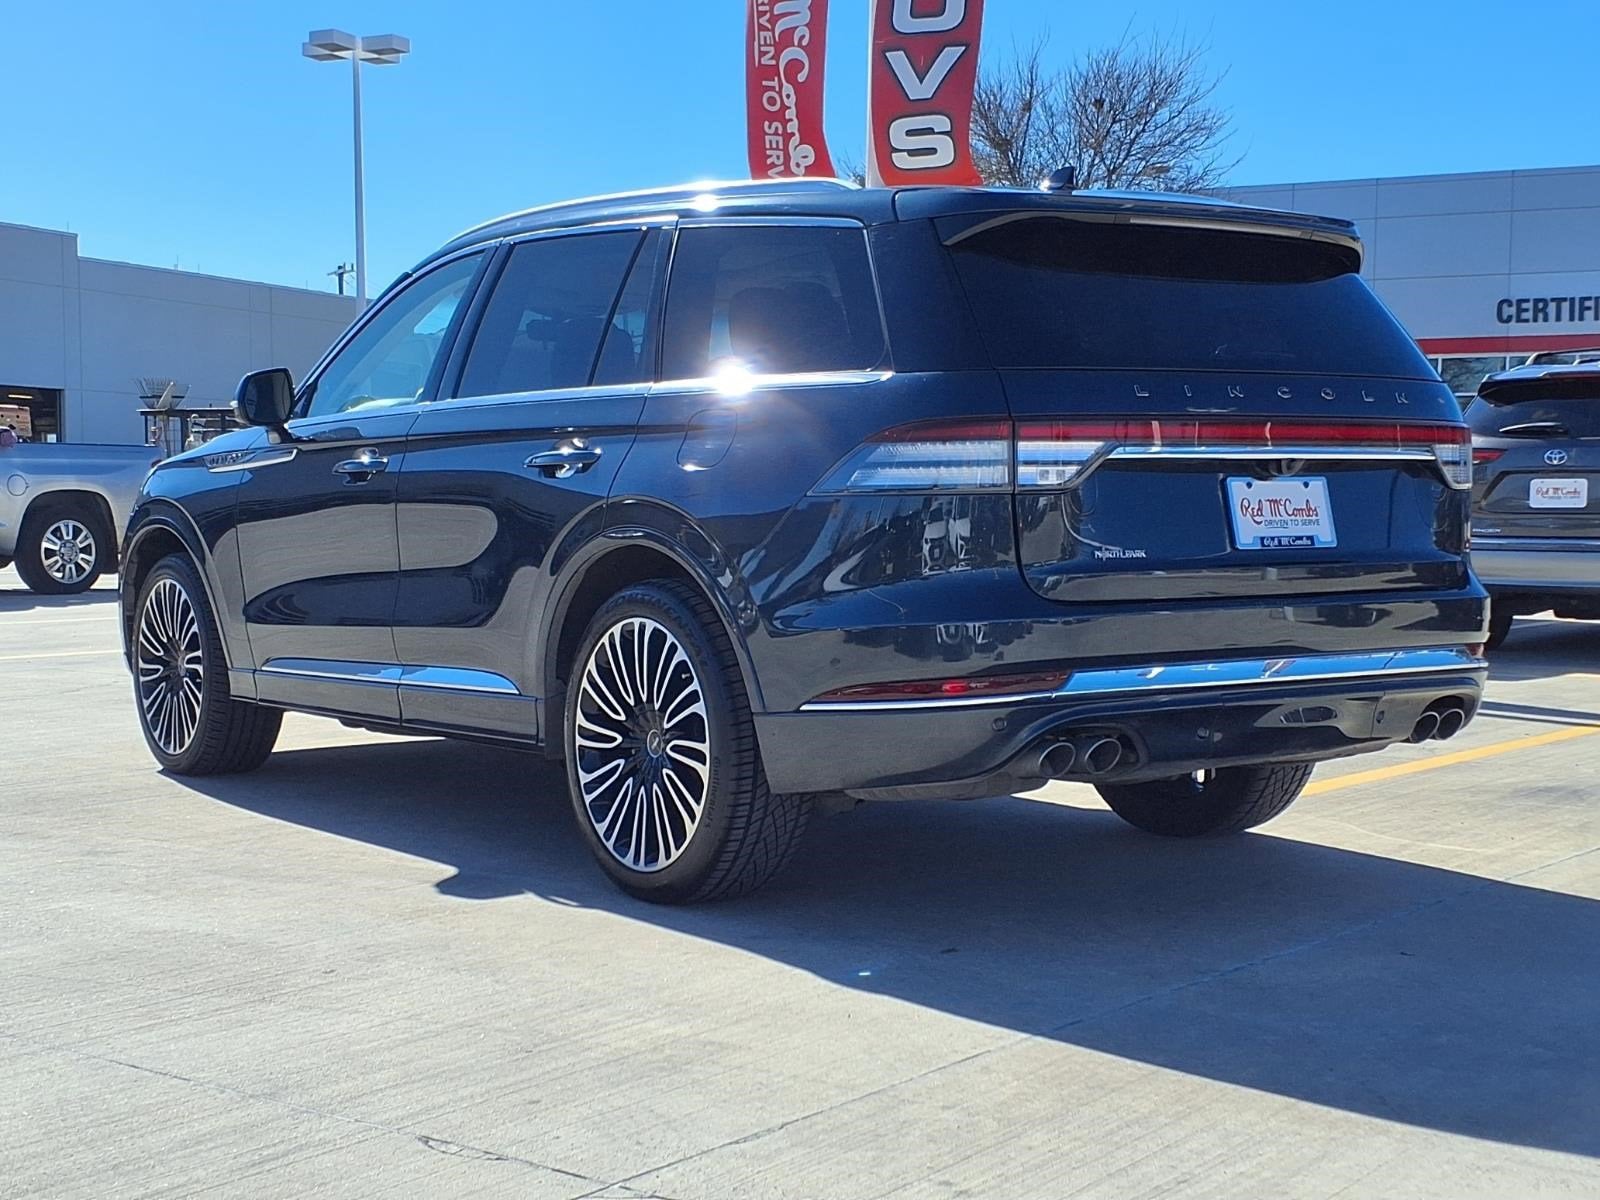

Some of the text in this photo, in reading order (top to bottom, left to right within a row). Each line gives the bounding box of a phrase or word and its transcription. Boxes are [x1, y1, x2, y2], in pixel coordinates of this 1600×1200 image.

[762, 76, 780, 112] TO
[1134, 384, 1409, 404] LINCOLN
[1240, 497, 1318, 525] Red McCombs
